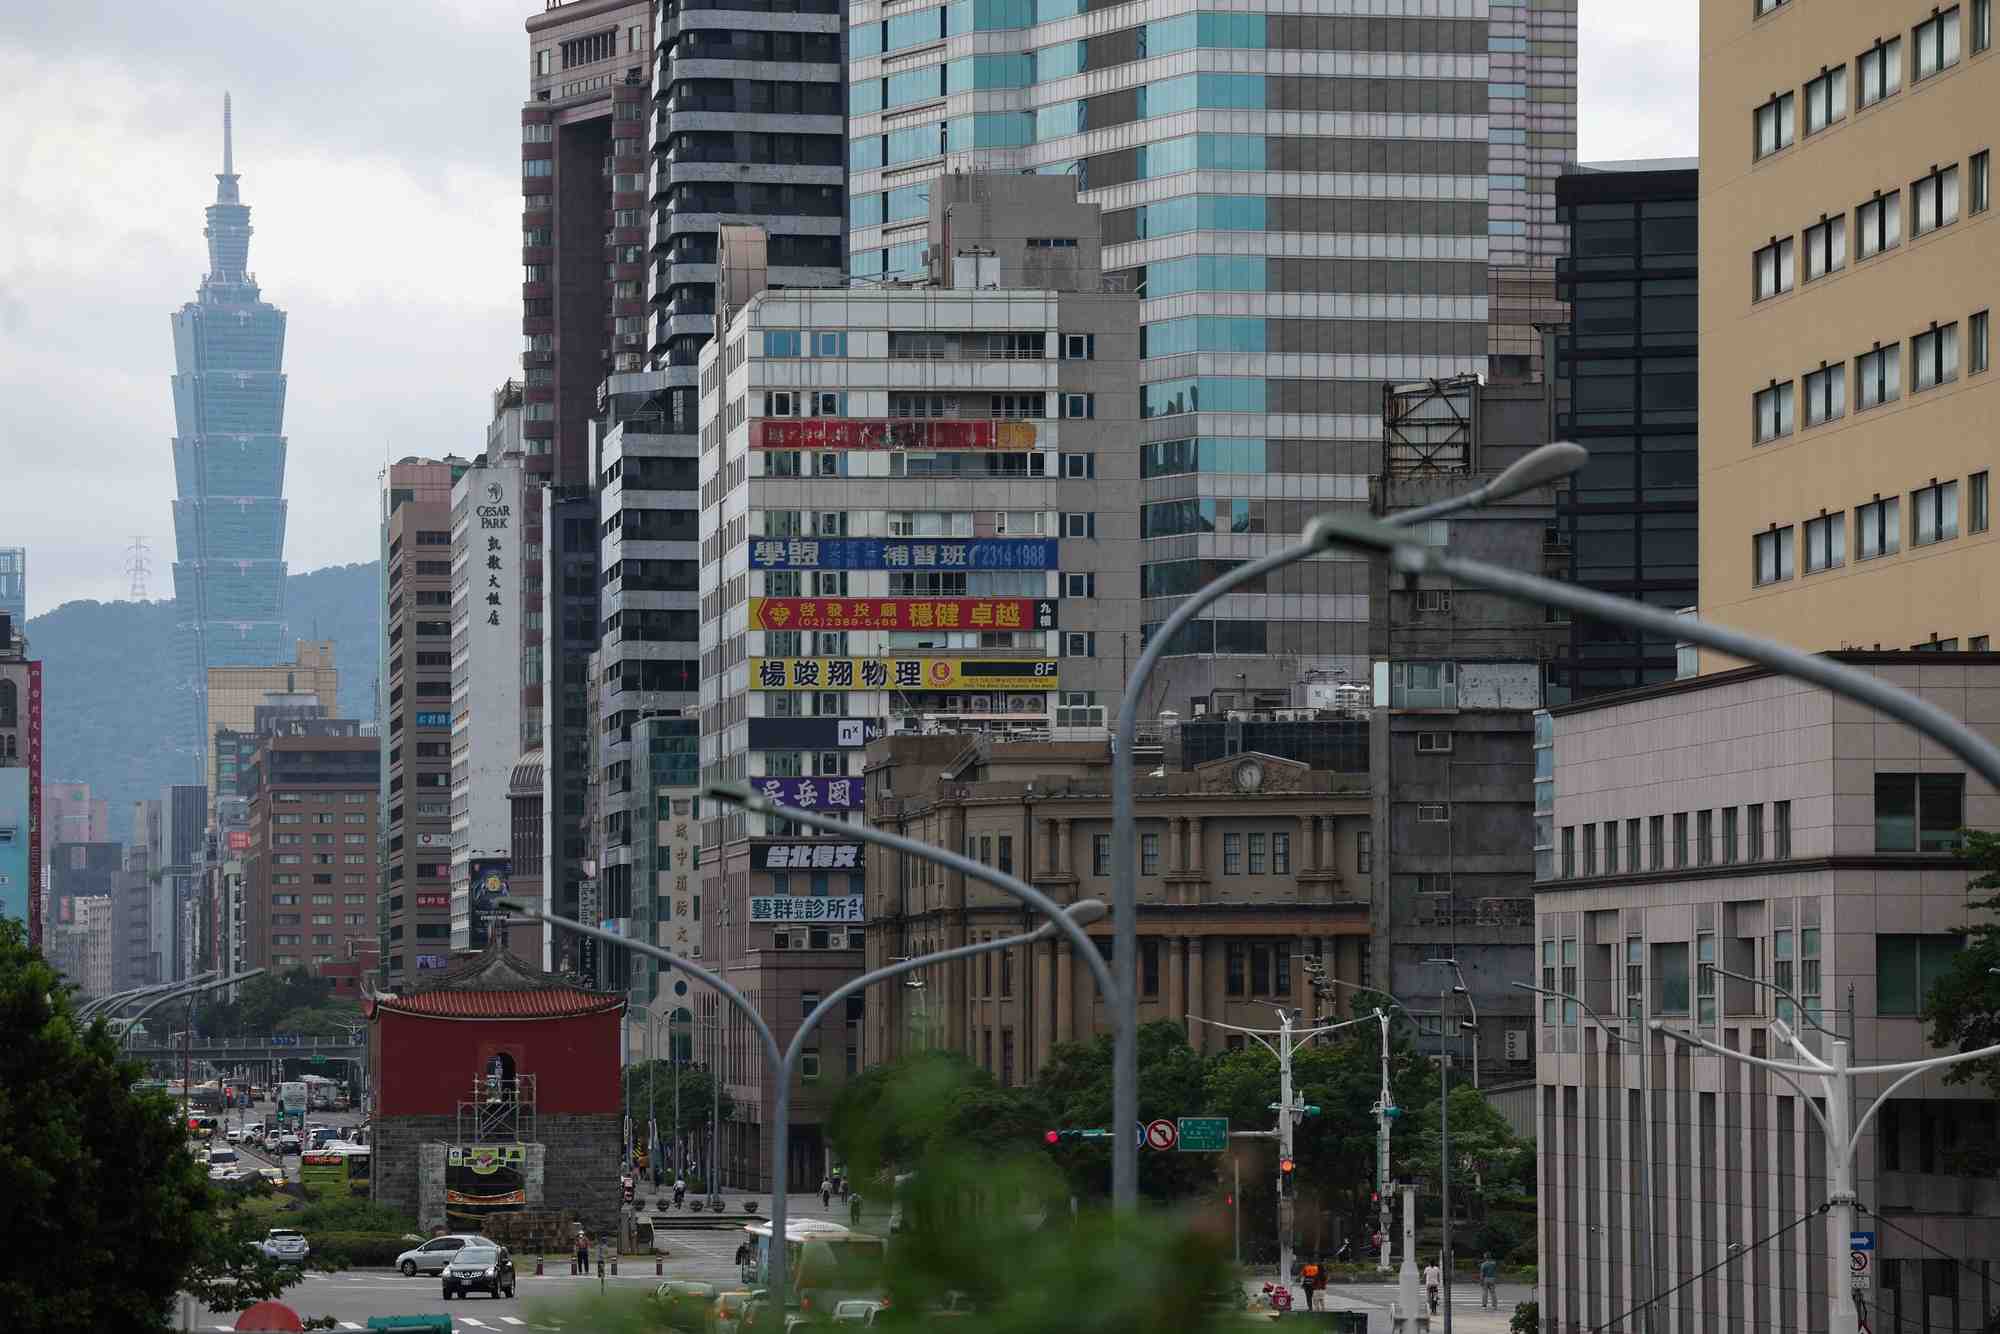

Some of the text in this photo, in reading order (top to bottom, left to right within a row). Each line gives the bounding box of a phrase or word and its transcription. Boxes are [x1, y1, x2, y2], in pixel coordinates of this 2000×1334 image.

[481, 517, 508, 529] PARK
[882, 543, 966, 566] 補習班
[486, 535, 503, 626] 凱撒大飯店
[970, 601, 1021, 627] 卓越
[1034, 662, 1055, 676] 8F
